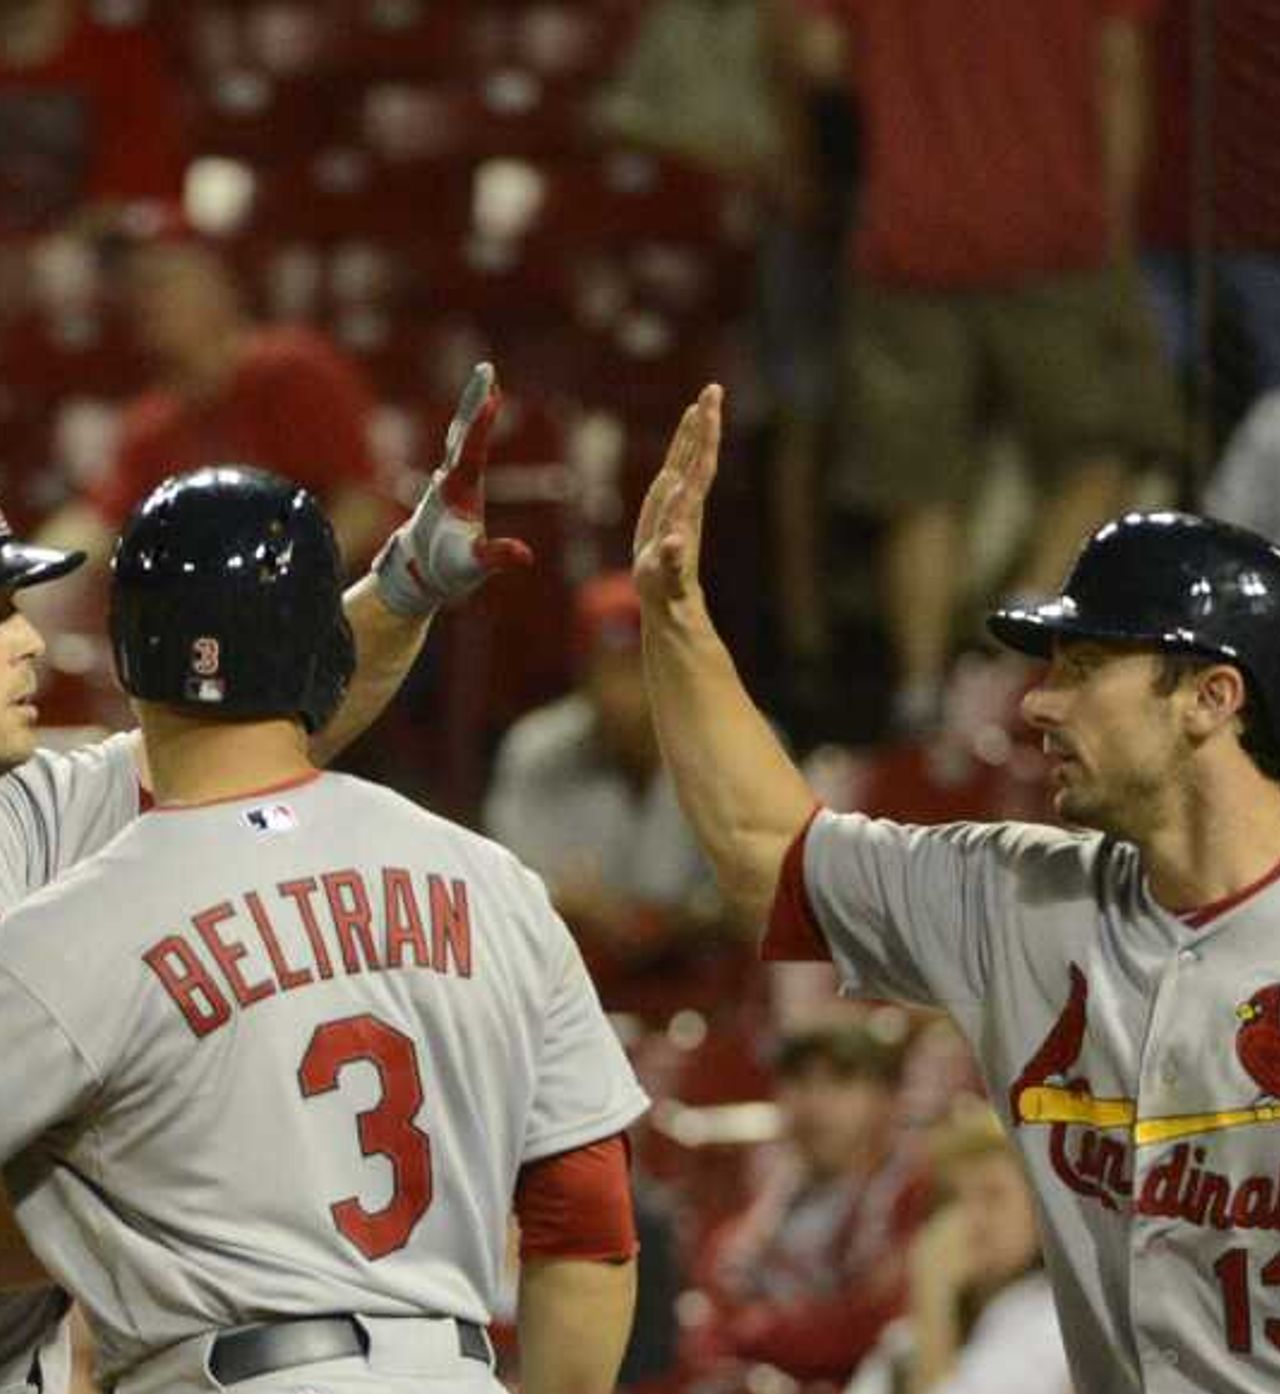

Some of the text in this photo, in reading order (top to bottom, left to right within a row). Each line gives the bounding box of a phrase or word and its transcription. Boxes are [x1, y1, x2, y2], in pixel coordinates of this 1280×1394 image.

[192, 637, 220, 674] 3
[141, 866, 473, 1040] BELTRAN
[296, 1012, 434, 1262] 3
